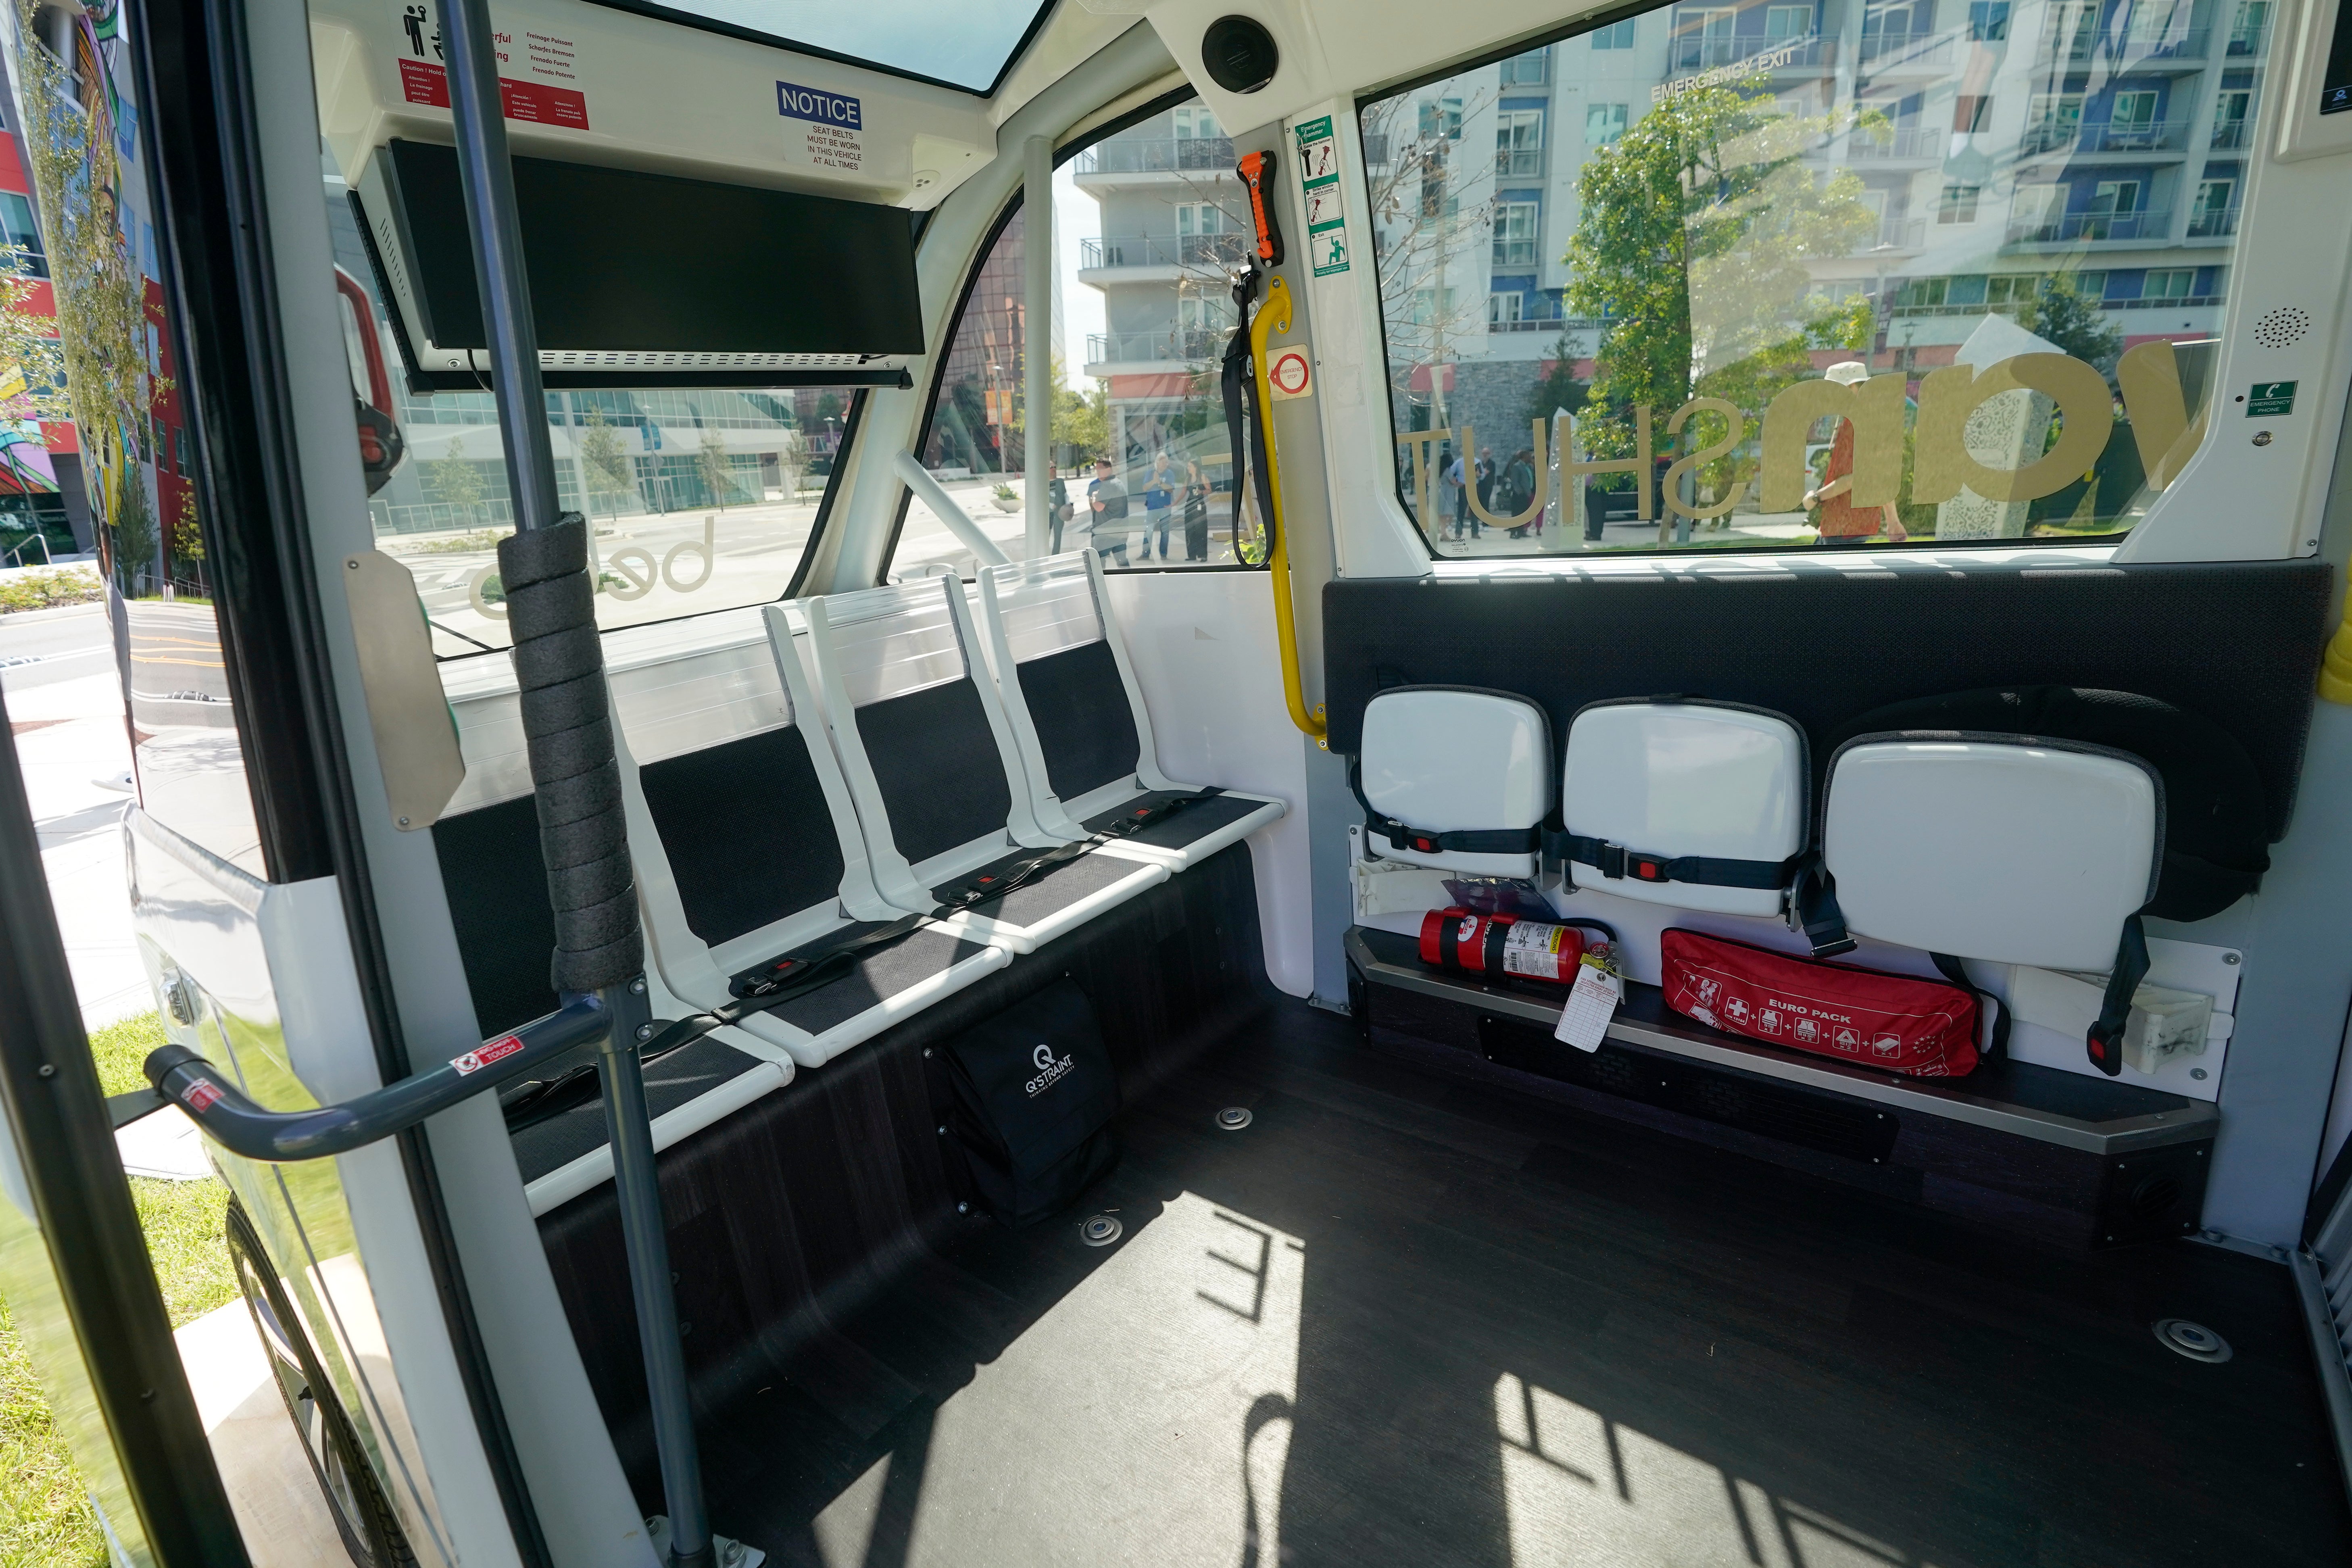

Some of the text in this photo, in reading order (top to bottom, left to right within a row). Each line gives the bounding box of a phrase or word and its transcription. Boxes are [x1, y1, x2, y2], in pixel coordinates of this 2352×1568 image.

[527, 32, 573, 47] Freinage Puissant
[528, 44, 574, 58] Scharfes Bremsen
[531, 55, 552, 64] Frenado
[402, 64, 423, 72] Caution
[533, 67, 575, 79] Frenado Potente
[1651, 46, 1795, 102] EMERGENCY EXIT
[782, 88, 859, 123] NOTICE
[813, 125, 853, 140] SEAT BELTS
[1301, 121, 1326, 132] Emergency
[1305, 129, 1323, 138] hammer
[807, 135, 827, 144] MUST
[839, 141, 860, 150] WORN
[816, 147, 832, 156] THIS
[834, 150, 861, 161] VEHICLE
[824, 158, 836, 167] ALL
[838, 161, 858, 170] TIMES
[1769, 999, 1851, 1024] EURO PACK
[486, 1044, 516, 1060] TOUCH
[1033, 1044, 1056, 1070] Q
[1026, 1054, 1072, 1093] Q'STRAINT
[1029, 1065, 1075, 1099] THINKING BEYOND SAFETY
